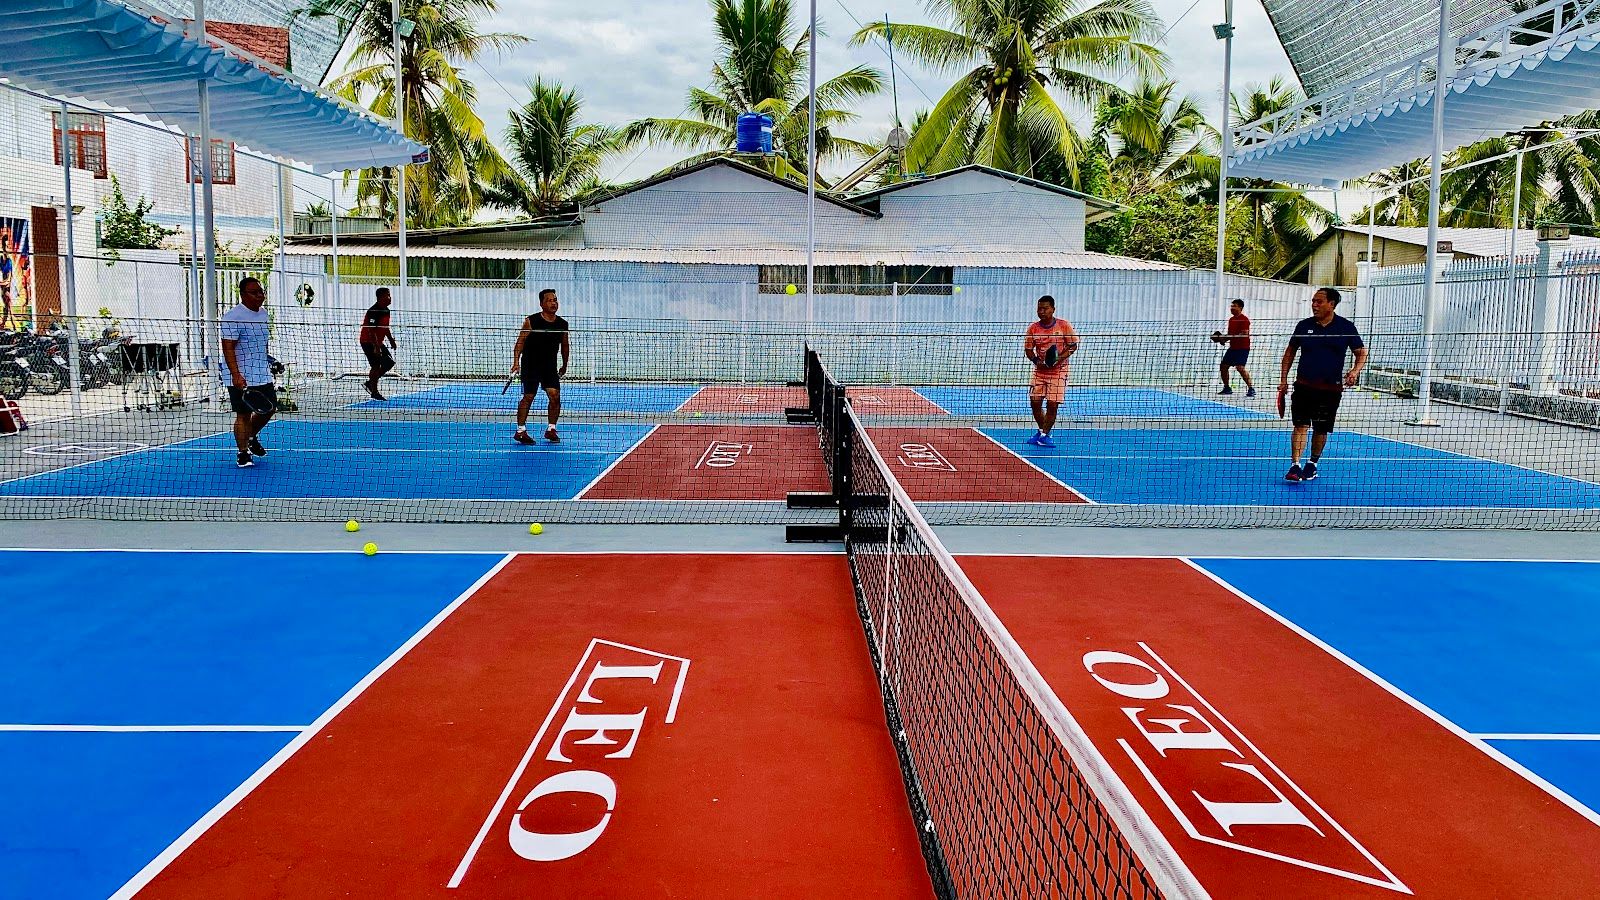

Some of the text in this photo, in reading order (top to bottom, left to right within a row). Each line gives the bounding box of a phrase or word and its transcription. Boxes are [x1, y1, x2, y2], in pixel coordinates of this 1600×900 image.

[706, 444, 742, 467] LEO
[900, 443, 944, 467] LEO
[508, 660, 664, 861] LEO
[1082, 650, 1326, 838] LEO
